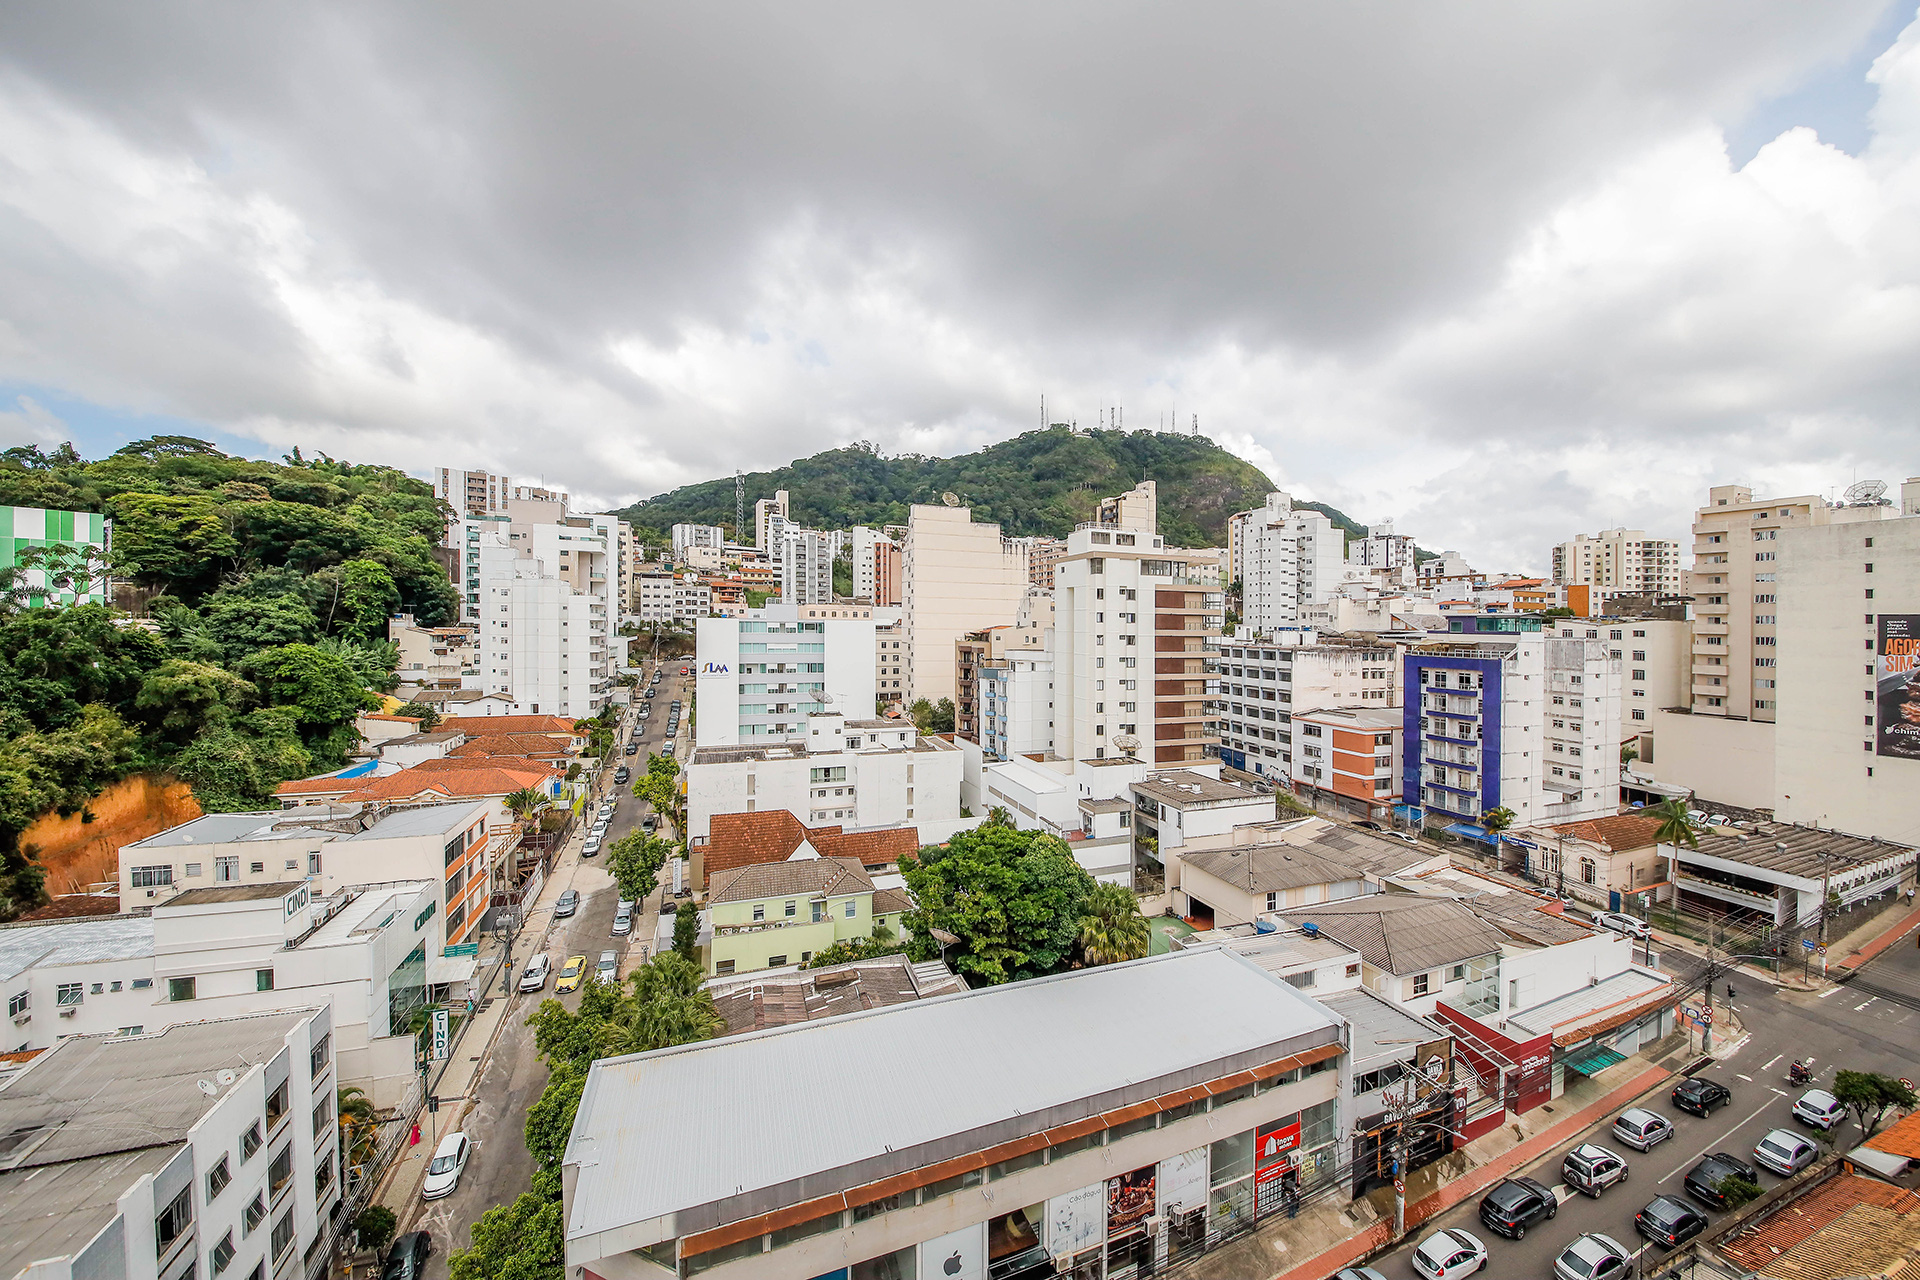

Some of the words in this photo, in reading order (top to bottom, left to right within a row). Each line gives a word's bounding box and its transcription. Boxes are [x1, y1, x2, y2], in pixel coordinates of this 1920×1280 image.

[1886, 655, 1913, 672] SIM
[287, 886, 309, 916] CINDI
[414, 900, 437, 932] CINDI
[436, 1012, 445, 1058] CINDI
[1277, 1135, 1295, 1146] Inova
